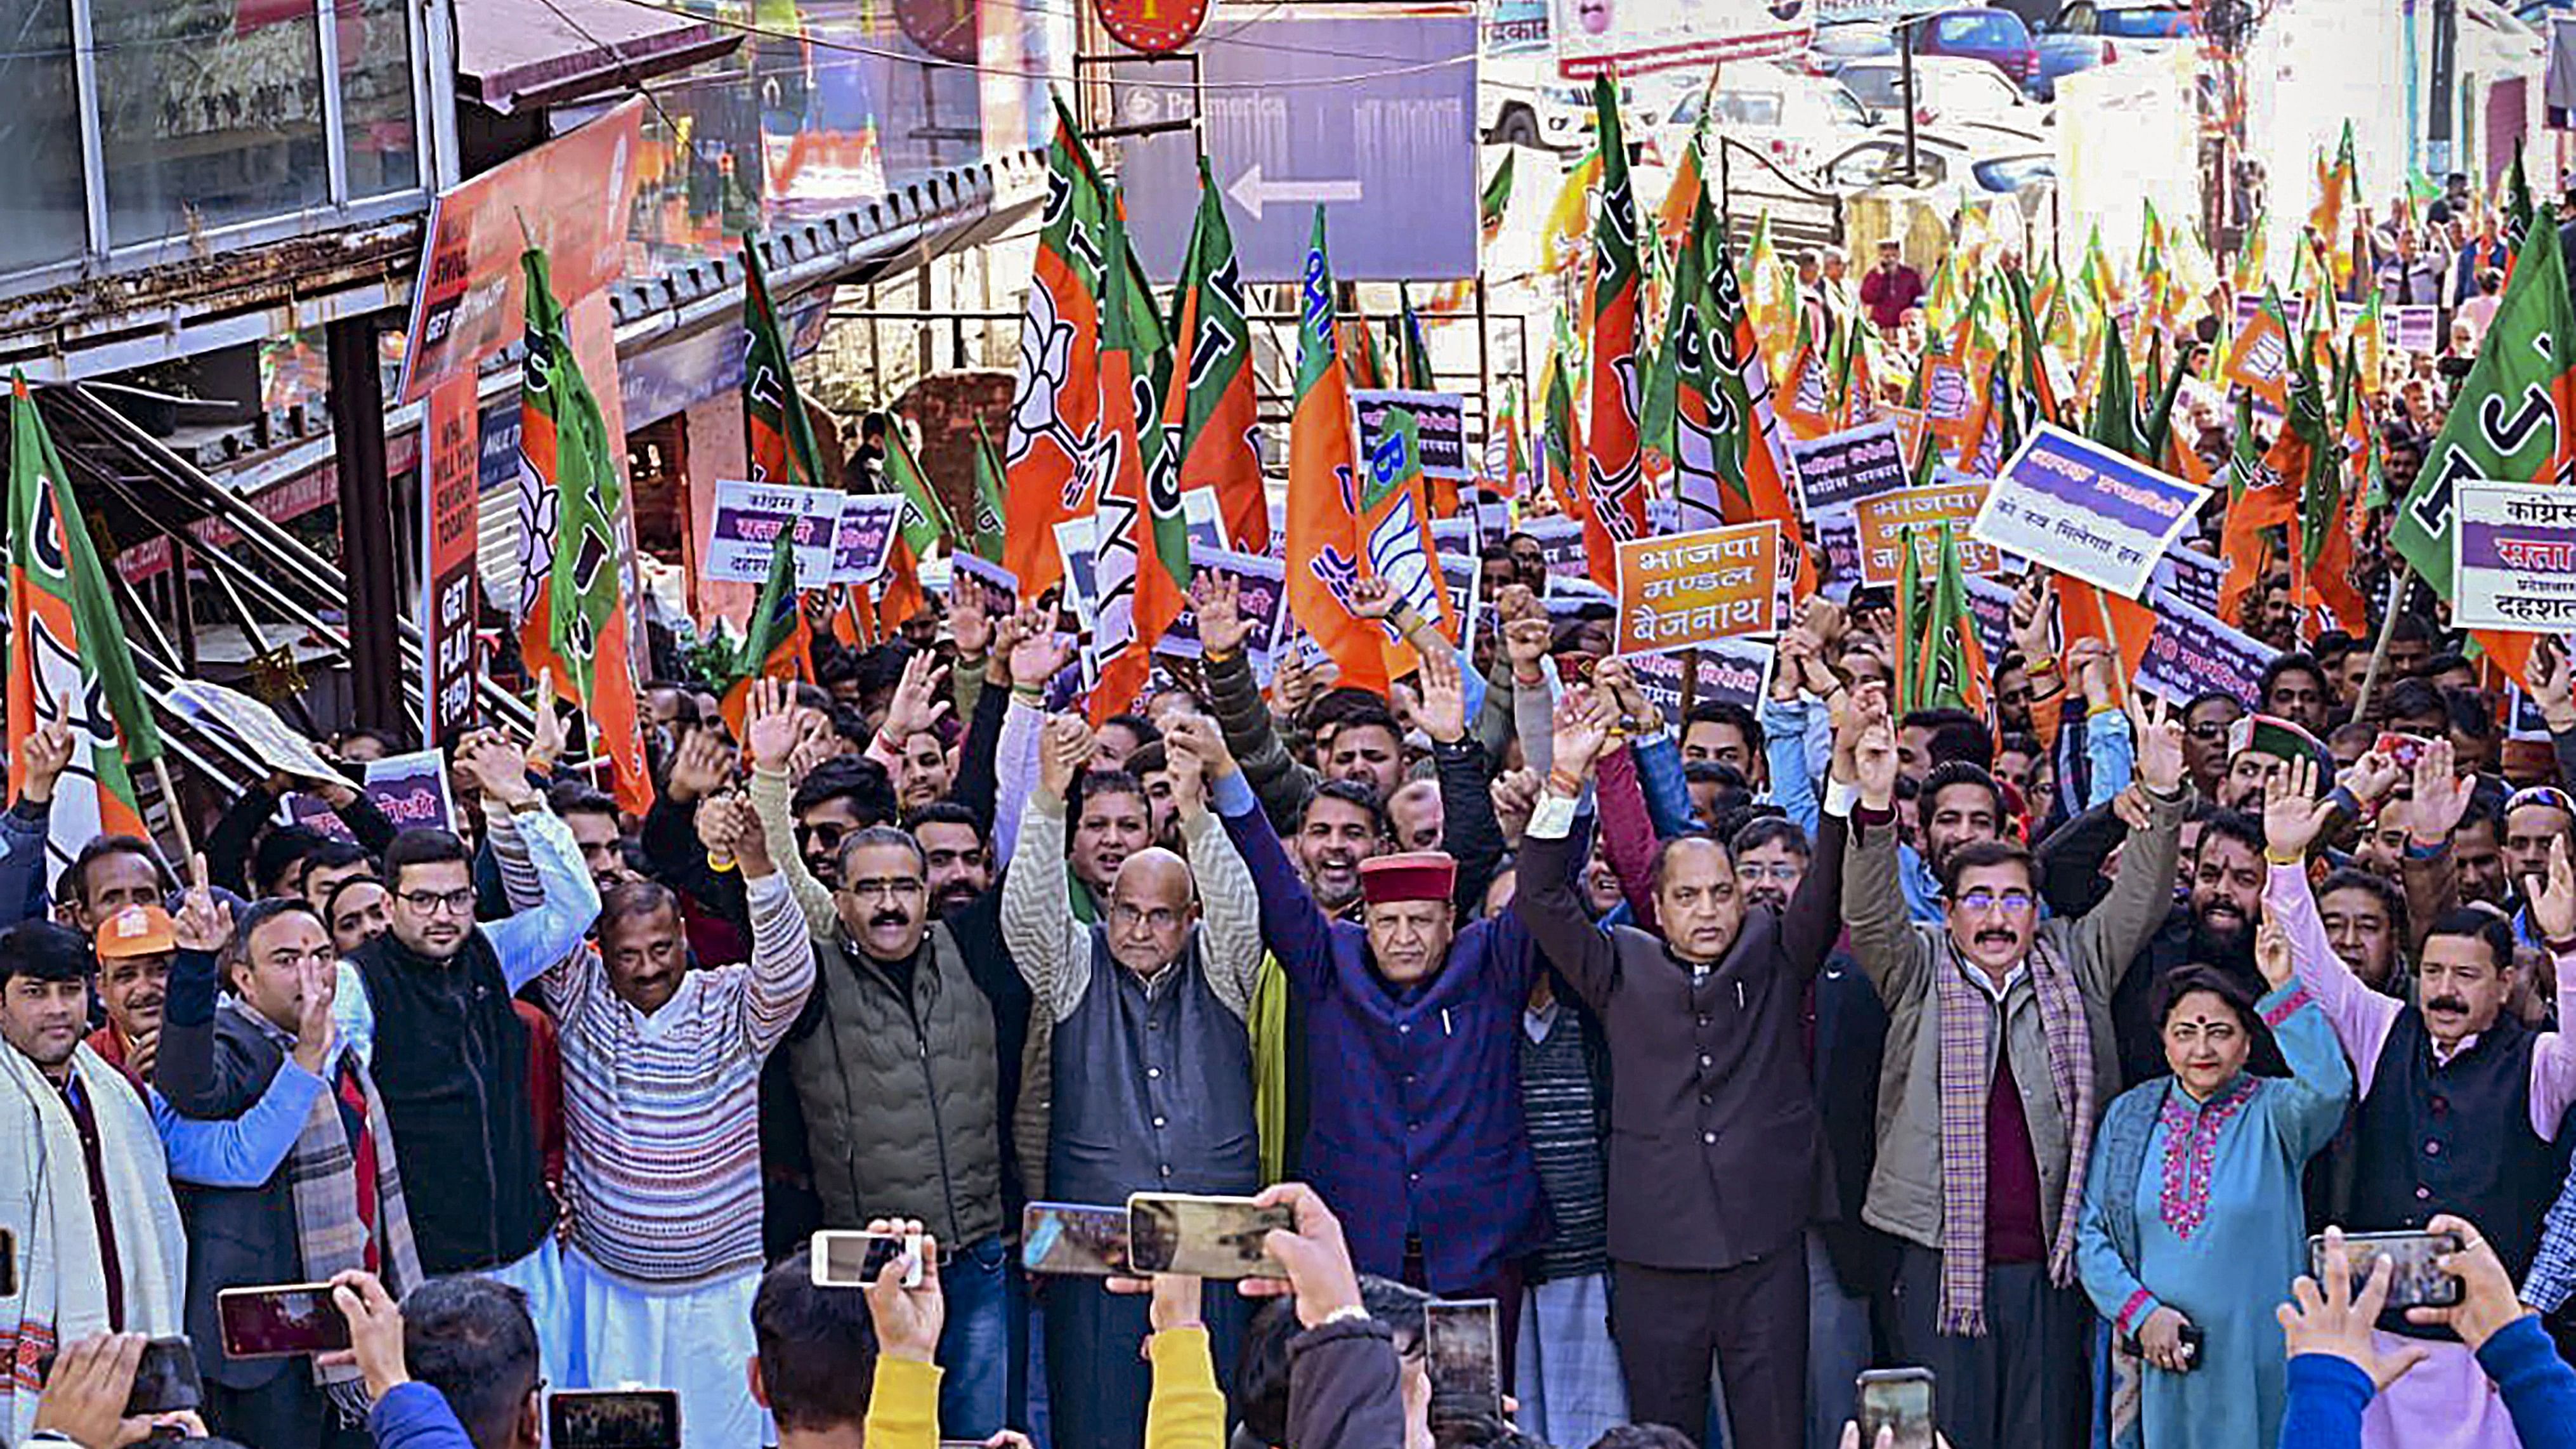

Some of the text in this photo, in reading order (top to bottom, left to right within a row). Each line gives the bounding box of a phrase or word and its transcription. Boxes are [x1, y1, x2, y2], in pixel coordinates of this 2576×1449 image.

[1639, 535, 1760, 570] भाजपा
[442, 574, 469, 627] GET
[1643, 566, 1756, 599] मण्डल
[1630, 598, 1763, 641] बैजनाथ
